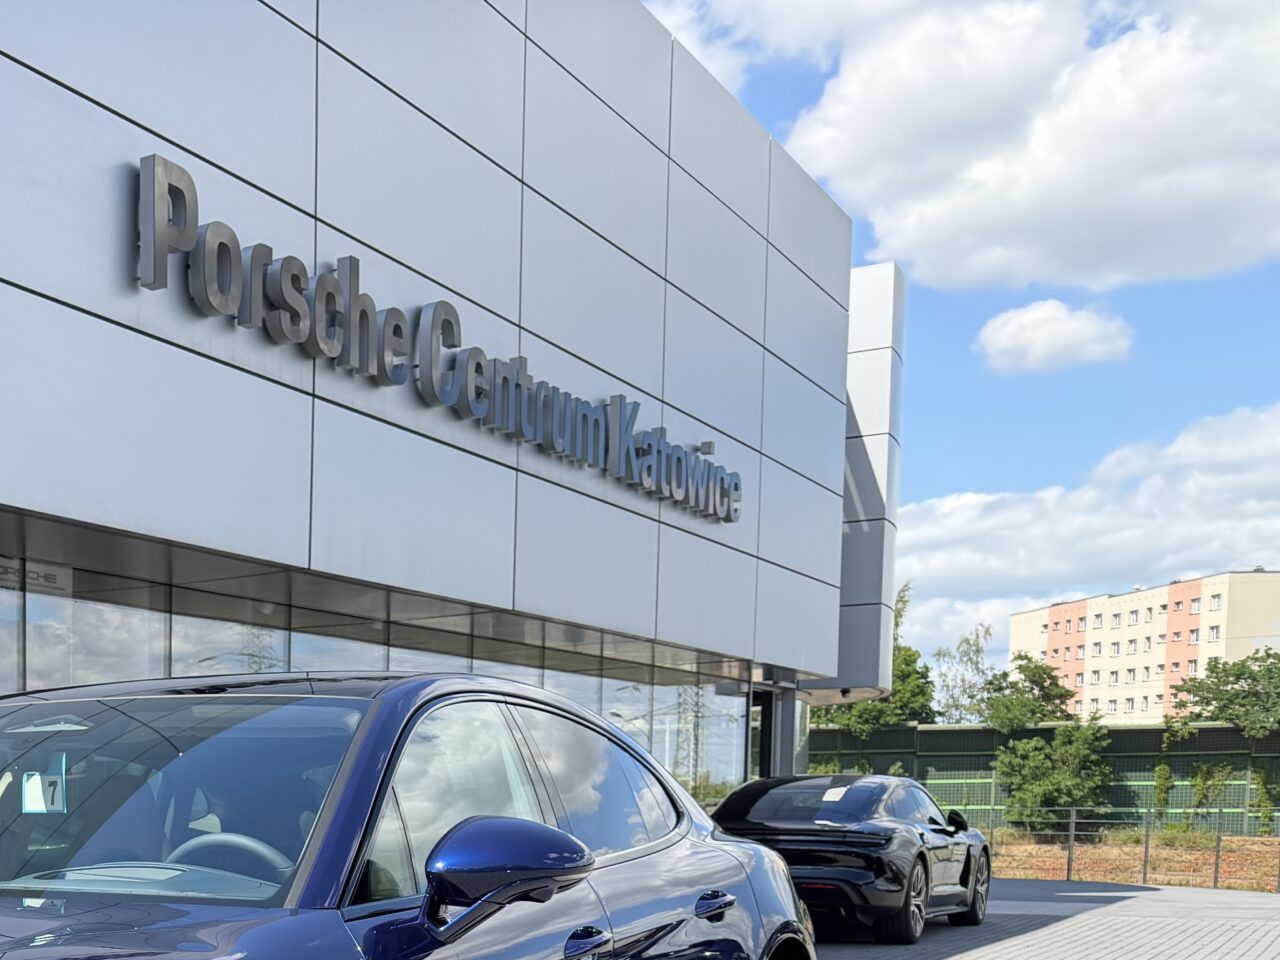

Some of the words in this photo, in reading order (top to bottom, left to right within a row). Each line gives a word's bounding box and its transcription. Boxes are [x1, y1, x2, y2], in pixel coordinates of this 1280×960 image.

[140, 153, 410, 386] Porsche
[419, 300, 606, 469] Centrum
[609, 394, 742, 523] Katowice
[48, 781, 58, 806] 7
